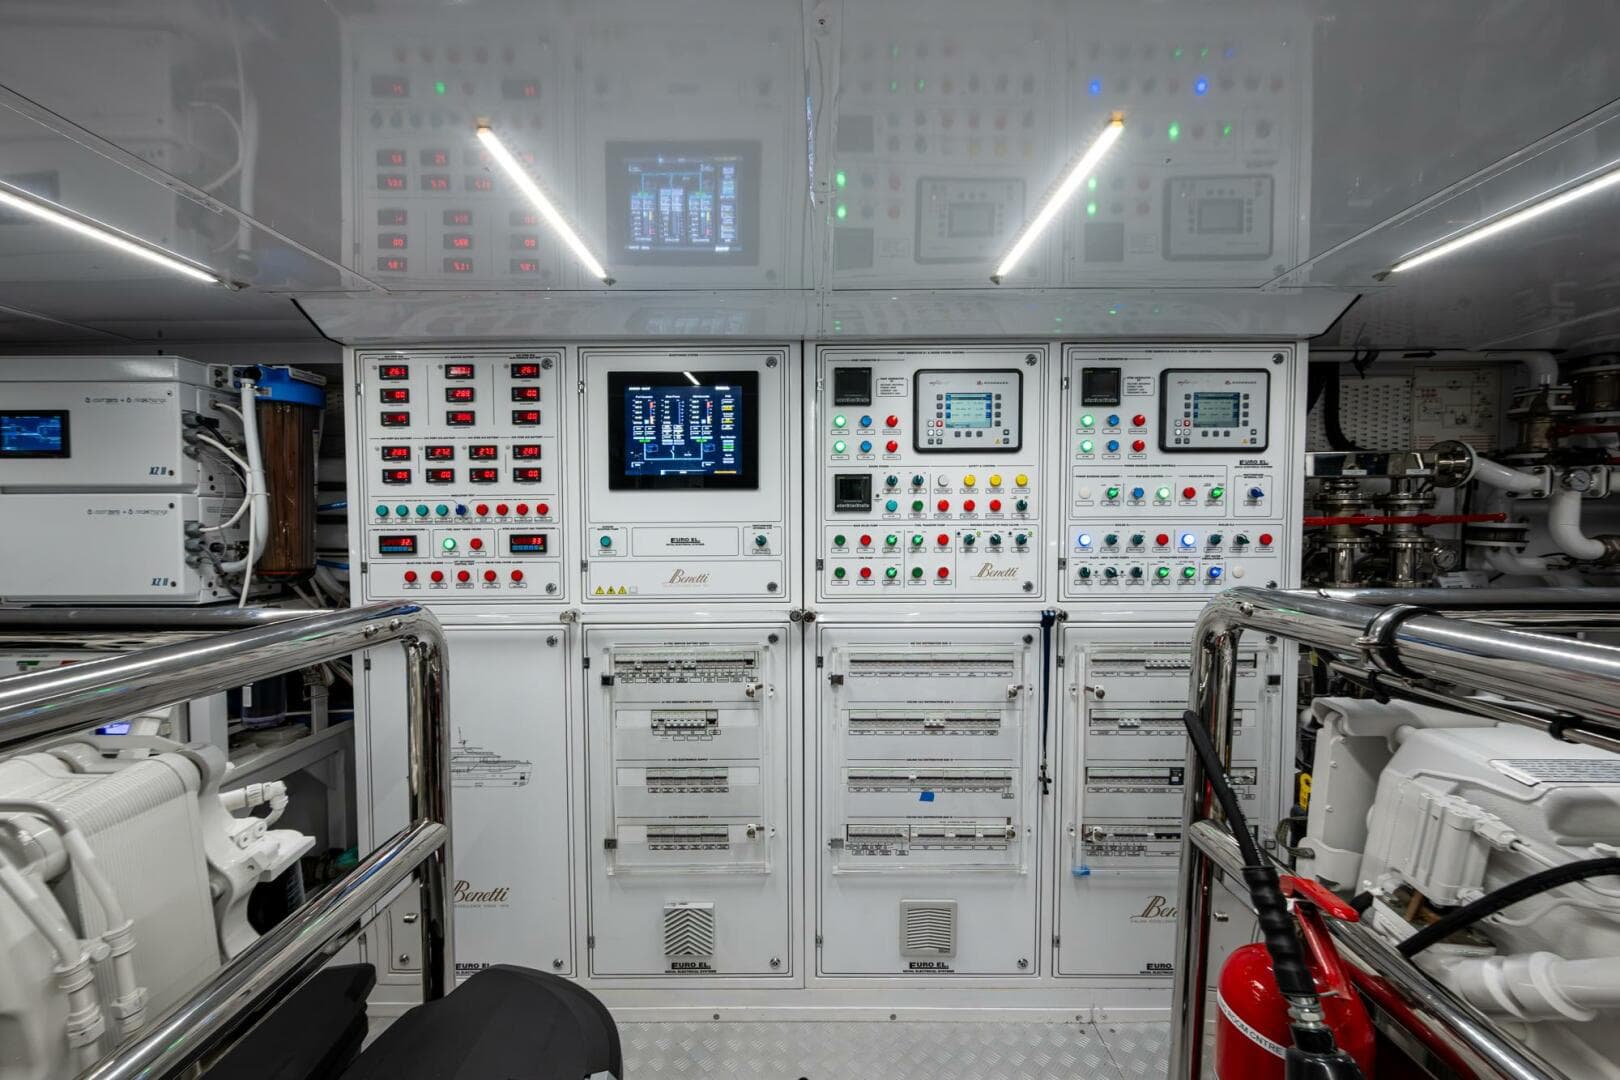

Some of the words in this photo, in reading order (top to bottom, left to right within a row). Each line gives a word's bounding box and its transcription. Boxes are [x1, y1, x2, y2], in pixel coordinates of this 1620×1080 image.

[974, 562, 1020, 578] Benetti
[667, 568, 711, 584] Benetti
[453, 879, 510, 903] Benetti
[455, 963, 480, 971] EURO
[671, 962, 697, 970] EURO
[909, 961, 935, 969] EURO
[1146, 962, 1173, 970] EURO
